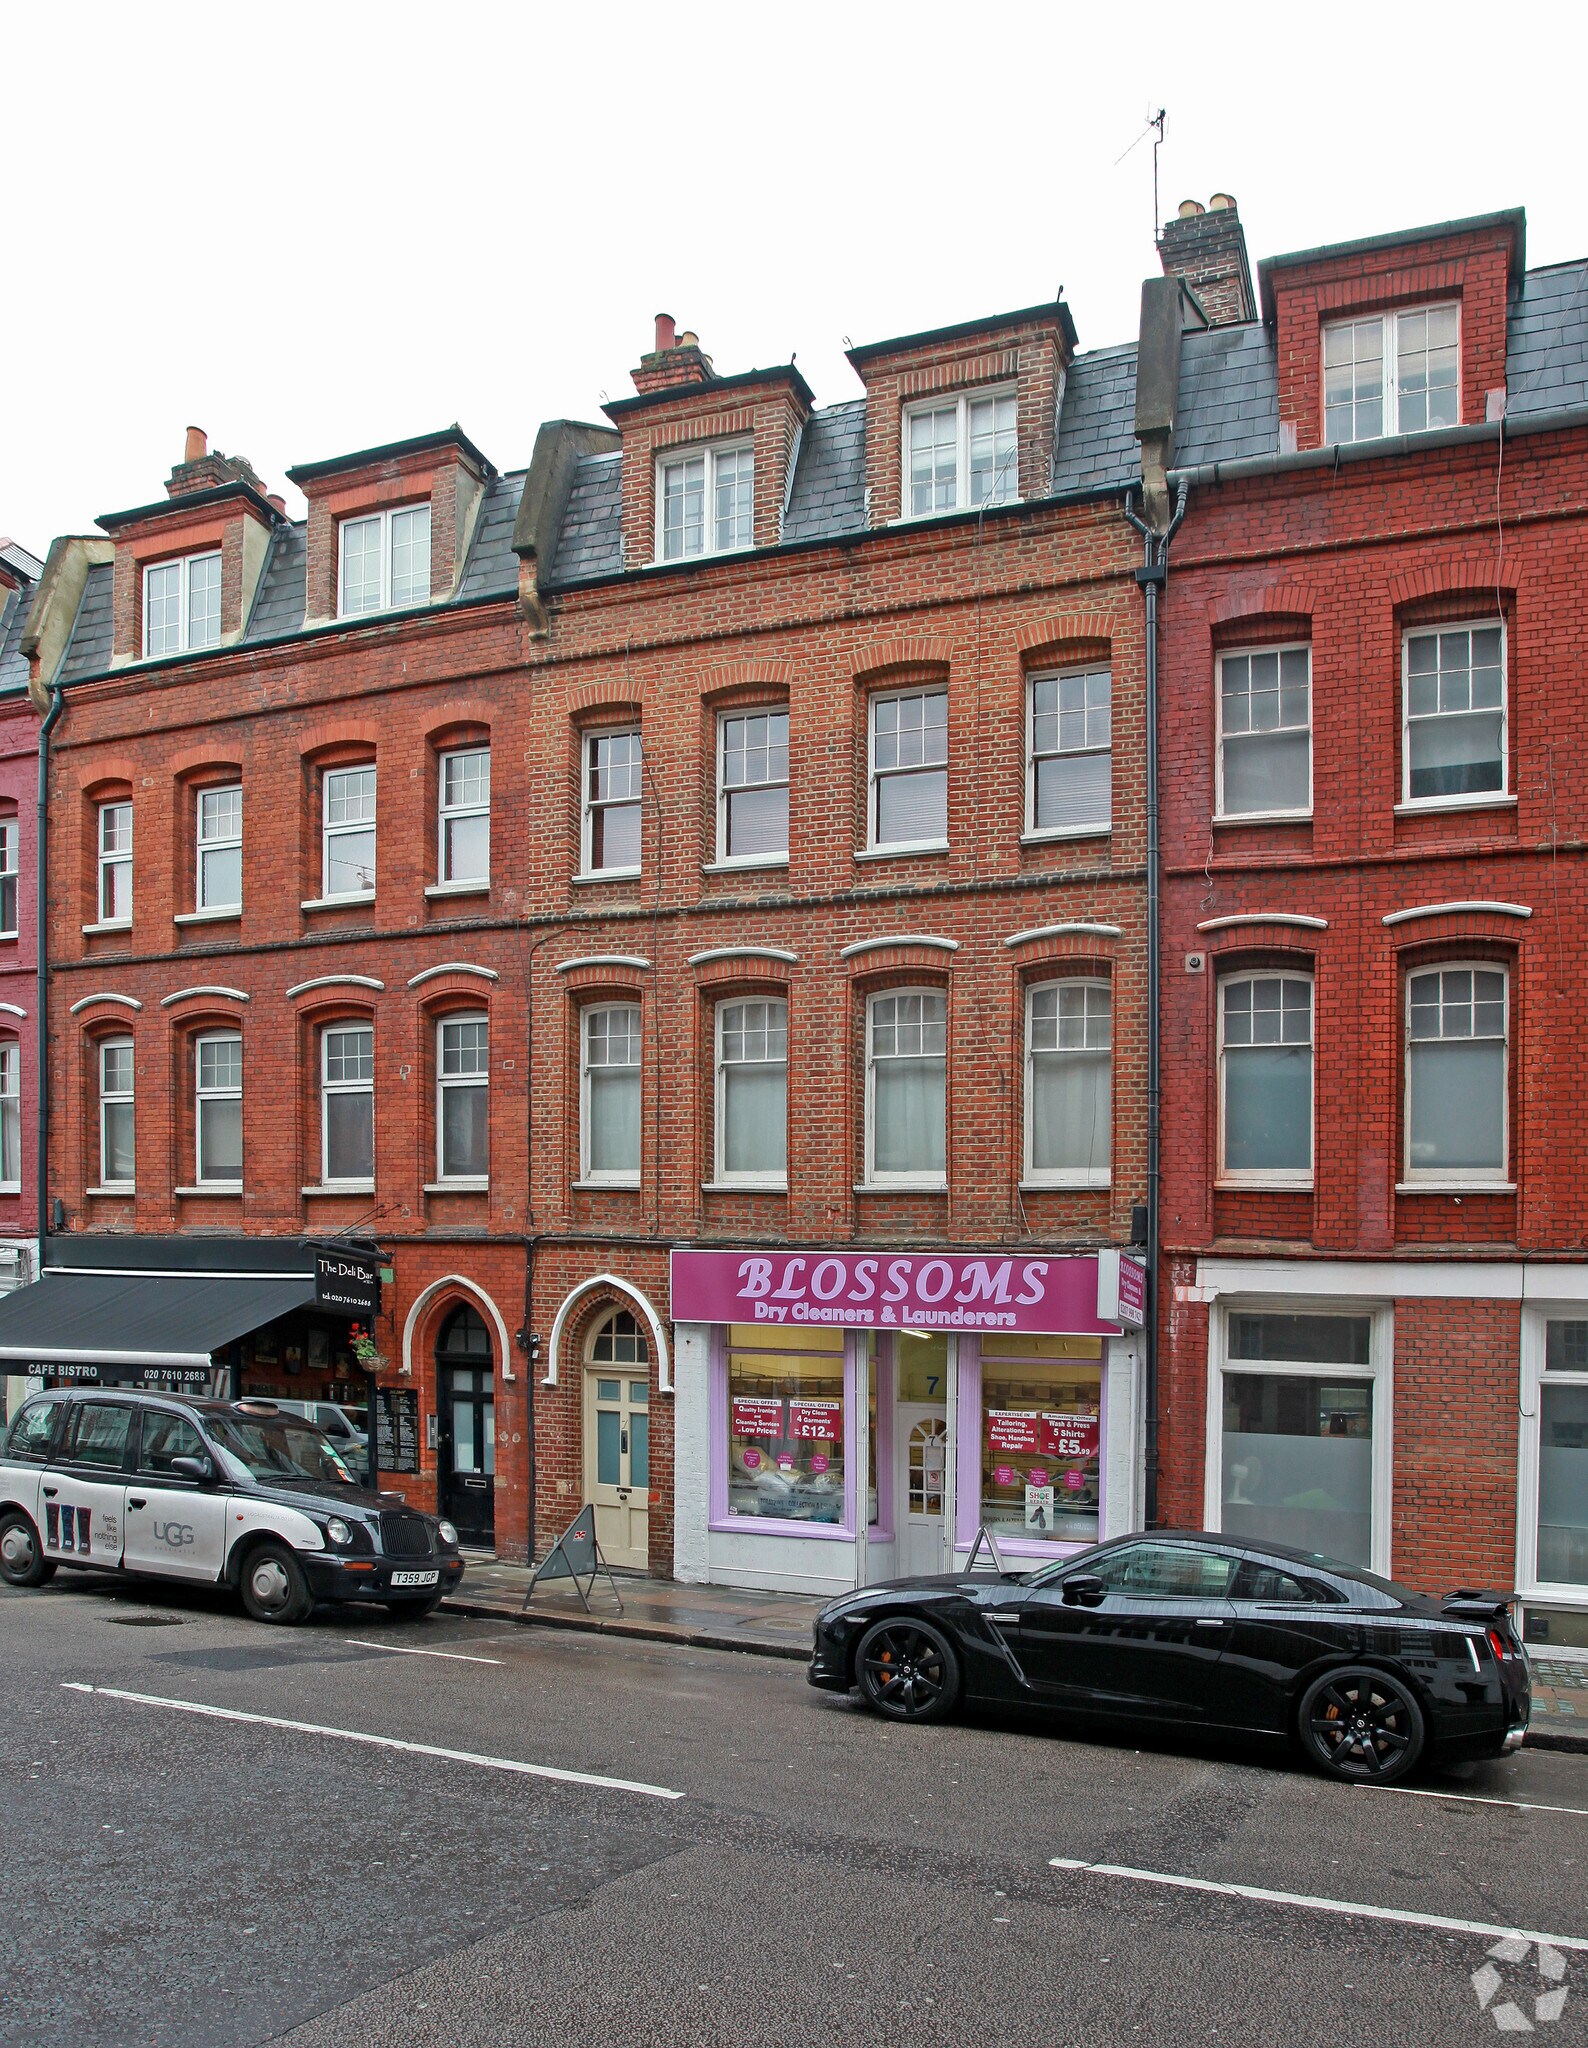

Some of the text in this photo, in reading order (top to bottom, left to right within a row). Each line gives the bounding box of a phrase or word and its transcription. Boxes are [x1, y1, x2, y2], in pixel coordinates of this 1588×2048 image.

[318, 1259, 373, 1280] The Deli Bar
[736, 1258, 1049, 1305] BLOSSOMS
[754, 1301, 1017, 1326] Dry Cleaners & Launderers
[28, 1364, 98, 1378] CAFE BISTRO
[144, 1369, 205, 1381] 020 7610 2688
[926, 1376, 940, 1395] 7
[738, 1405, 777, 1415] Quality Ironing
[801, 1409, 811, 1417] Dry
[735, 1418, 780, 1427] Cleaning Services
[796, 1415, 802, 1423] 4
[997, 1419, 1028, 1428] Tailoring,
[756, 1427, 777, 1435] Prices
[801, 1425, 835, 1438] £12.99
[991, 1426, 1025, 1434] Alterations
[1053, 1428, 1085, 1438] 5 Shirts
[929, 1435, 936, 1447] 7
[1008, 1435, 1034, 1443] Handbag
[1001, 1442, 1023, 1450] Repair
[1058, 1438, 1091, 1455] £5.99
[1029, 1491, 1050, 1500] SHOE
[102, 1514, 117, 1524] feels
[106, 1523, 117, 1533] like
[94, 1532, 118, 1544] nothing
[154, 1521, 195, 1548] UGG
[104, 1542, 118, 1552] else
[396, 1572, 436, 1584] T359 JGP
